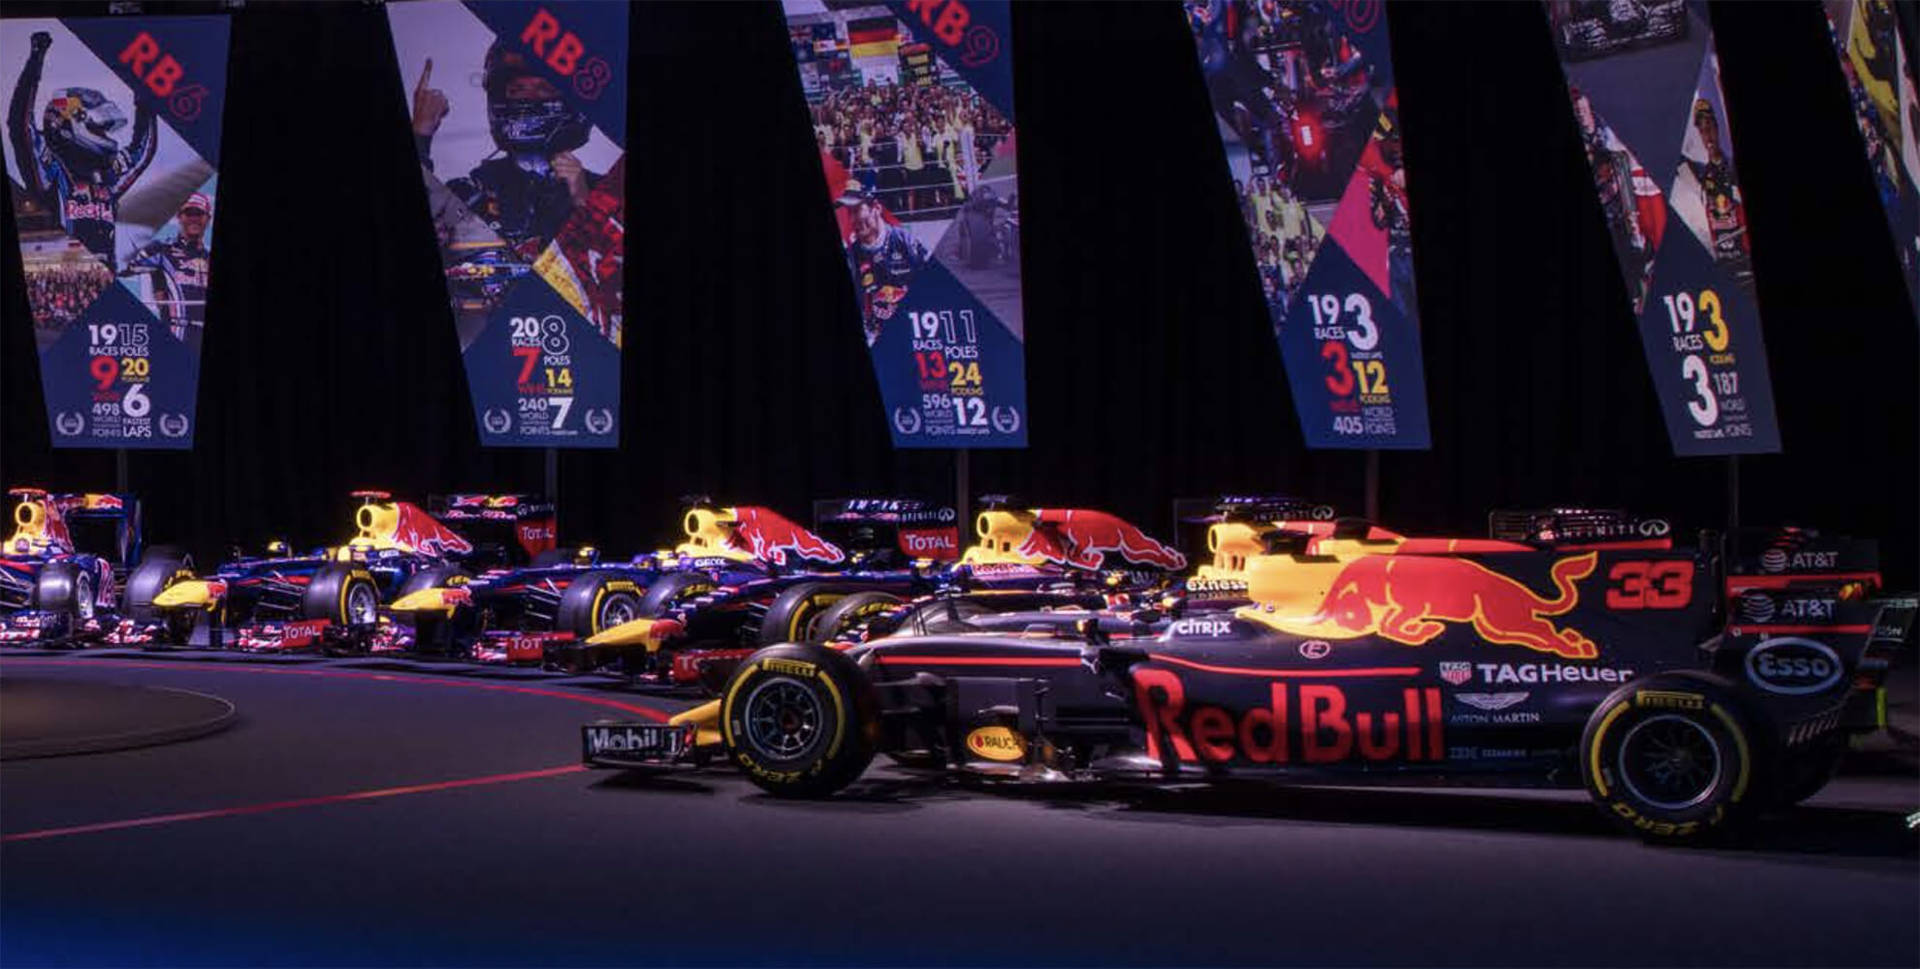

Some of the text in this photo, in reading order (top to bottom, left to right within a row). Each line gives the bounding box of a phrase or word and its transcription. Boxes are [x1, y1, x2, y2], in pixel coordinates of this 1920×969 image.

[510, 315, 570, 355] 20 8
[1308, 293, 1379, 350] 19 3
[1663, 289, 1729, 352] 19 3
[912, 339, 944, 351] RACES
[1672, 334, 1704, 352] RACES
[90, 356, 150, 392] 9 20
[512, 347, 543, 385] 7
[545, 368, 573, 388] 14
[915, 350, 948, 379] 13
[949, 361, 983, 386] 24
[1321, 341, 1355, 396] 3
[1352, 360, 1389, 394] 12
[122, 384, 151, 417] 6
[923, 394, 951, 409] 596
[1683, 354, 1739, 427] 3 187
[92, 402, 120, 416] 498
[518, 398, 548, 411] 240
[548, 397, 574, 429] 7
[953, 397, 988, 426] 12
[1333, 416, 1364, 435] 405
[905, 533, 956, 551] TOTAL
[1792, 551, 1839, 568] AT&T
[1186, 576, 1249, 592] exness
[1605, 561, 1694, 609] 33
[1782, 599, 1836, 617] AT&T
[282, 625, 322, 640] TOTAL
[586, 727, 657, 752] Mobil
